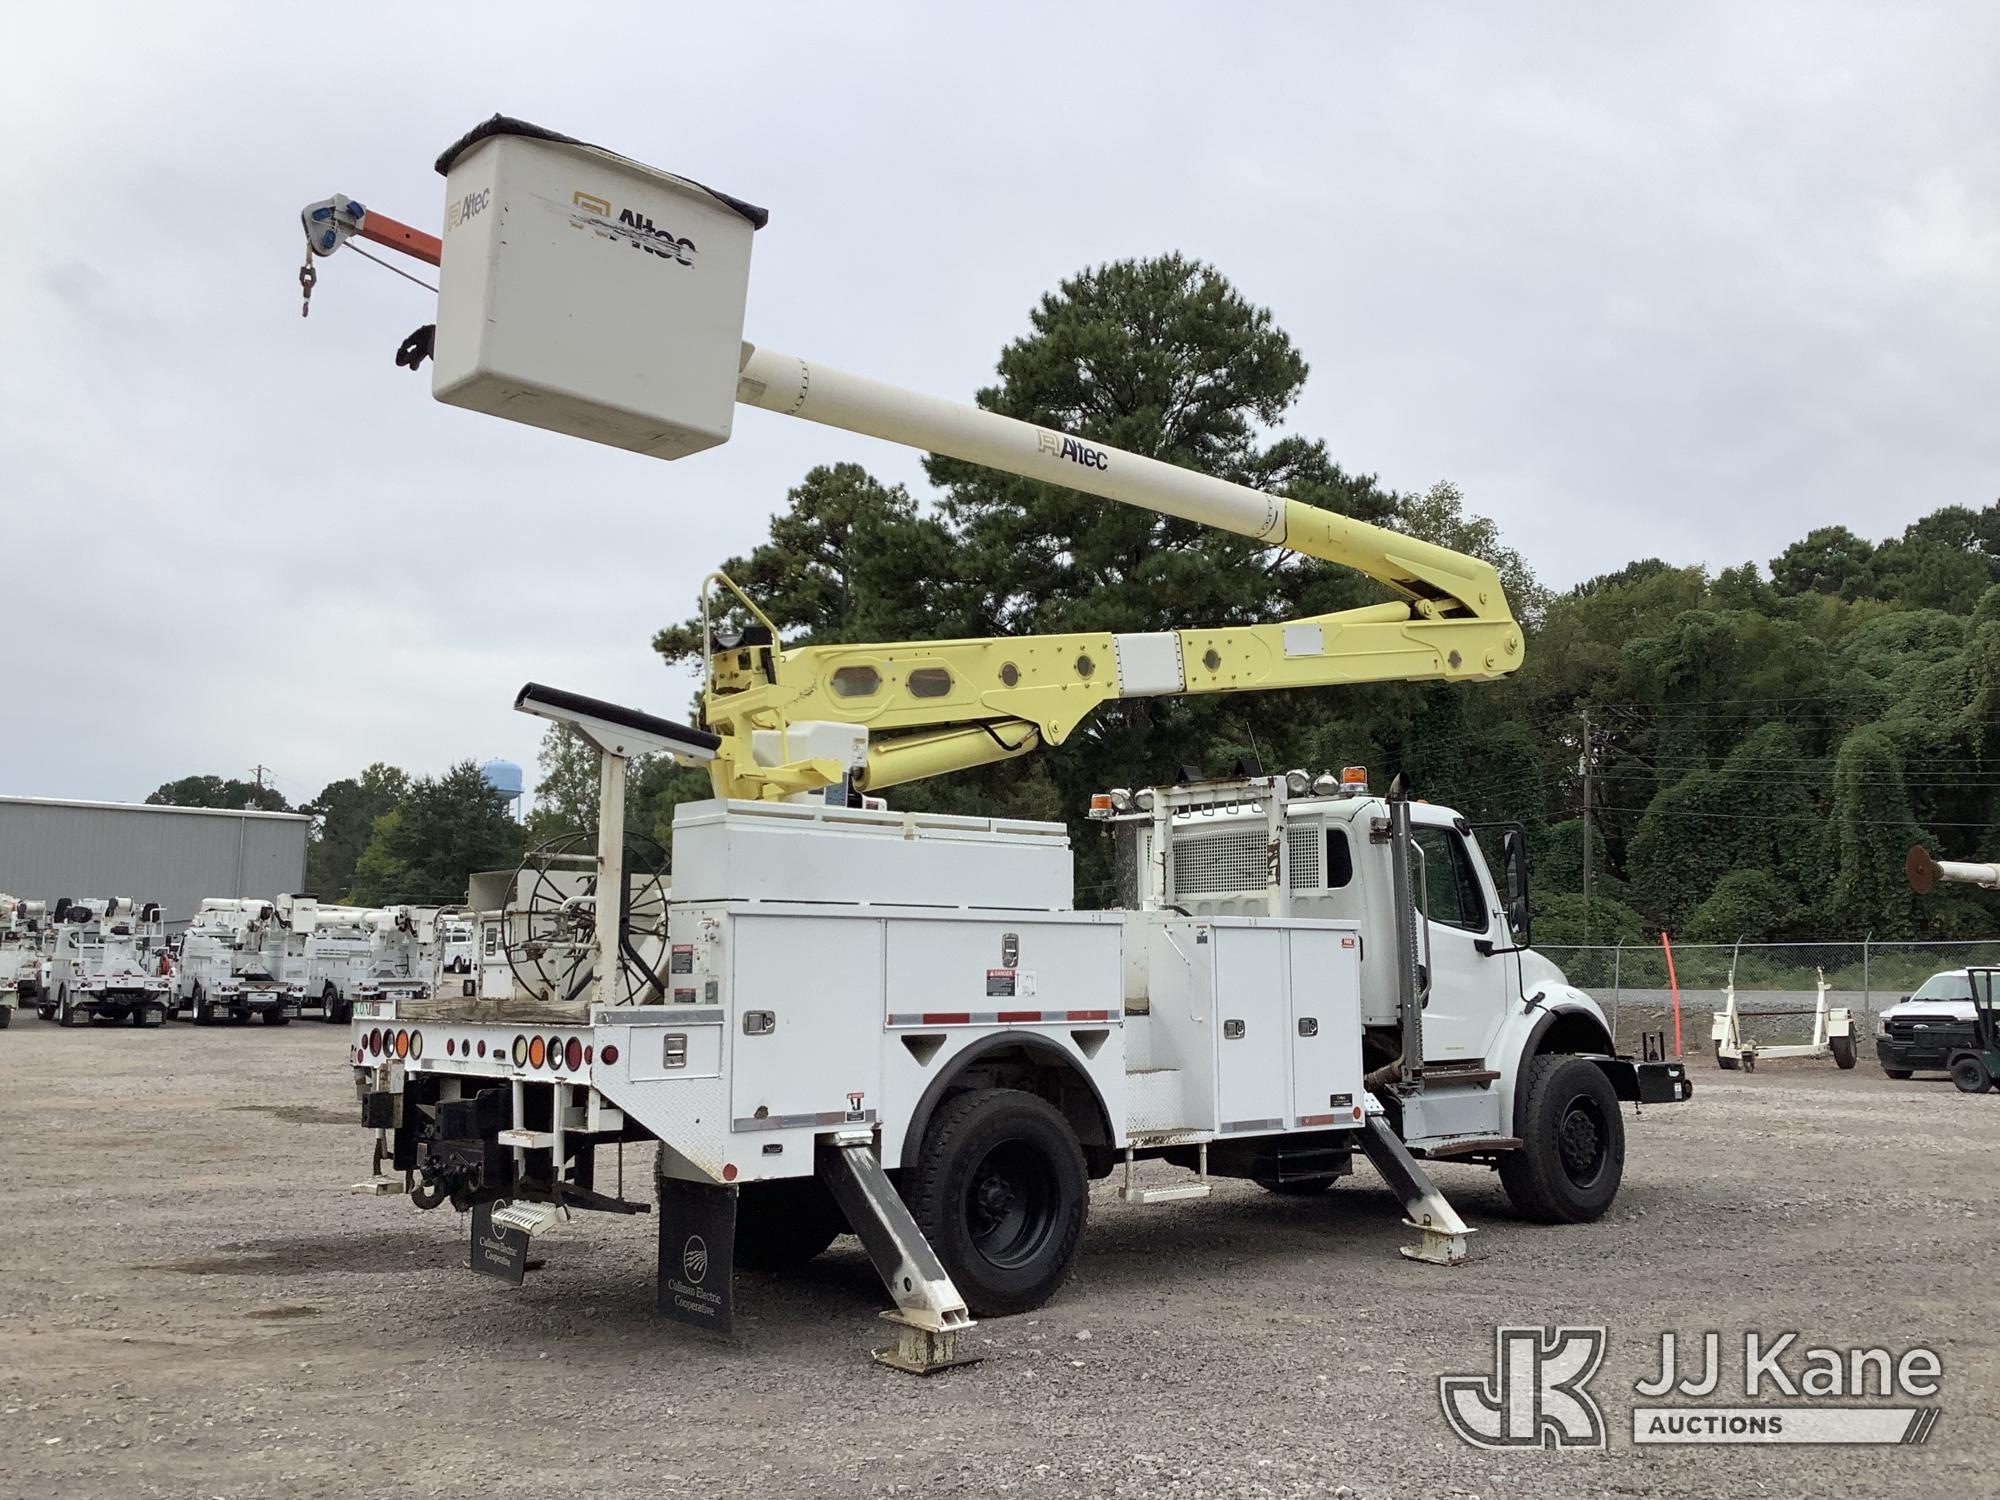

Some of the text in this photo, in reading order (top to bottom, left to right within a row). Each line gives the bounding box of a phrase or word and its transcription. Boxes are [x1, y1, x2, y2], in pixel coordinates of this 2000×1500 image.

[460, 187, 490, 225] Altec
[1060, 437, 1109, 471] Altec
[674, 1294, 715, 1317] Cooperative
[696, 1286, 722, 1305] Electric
